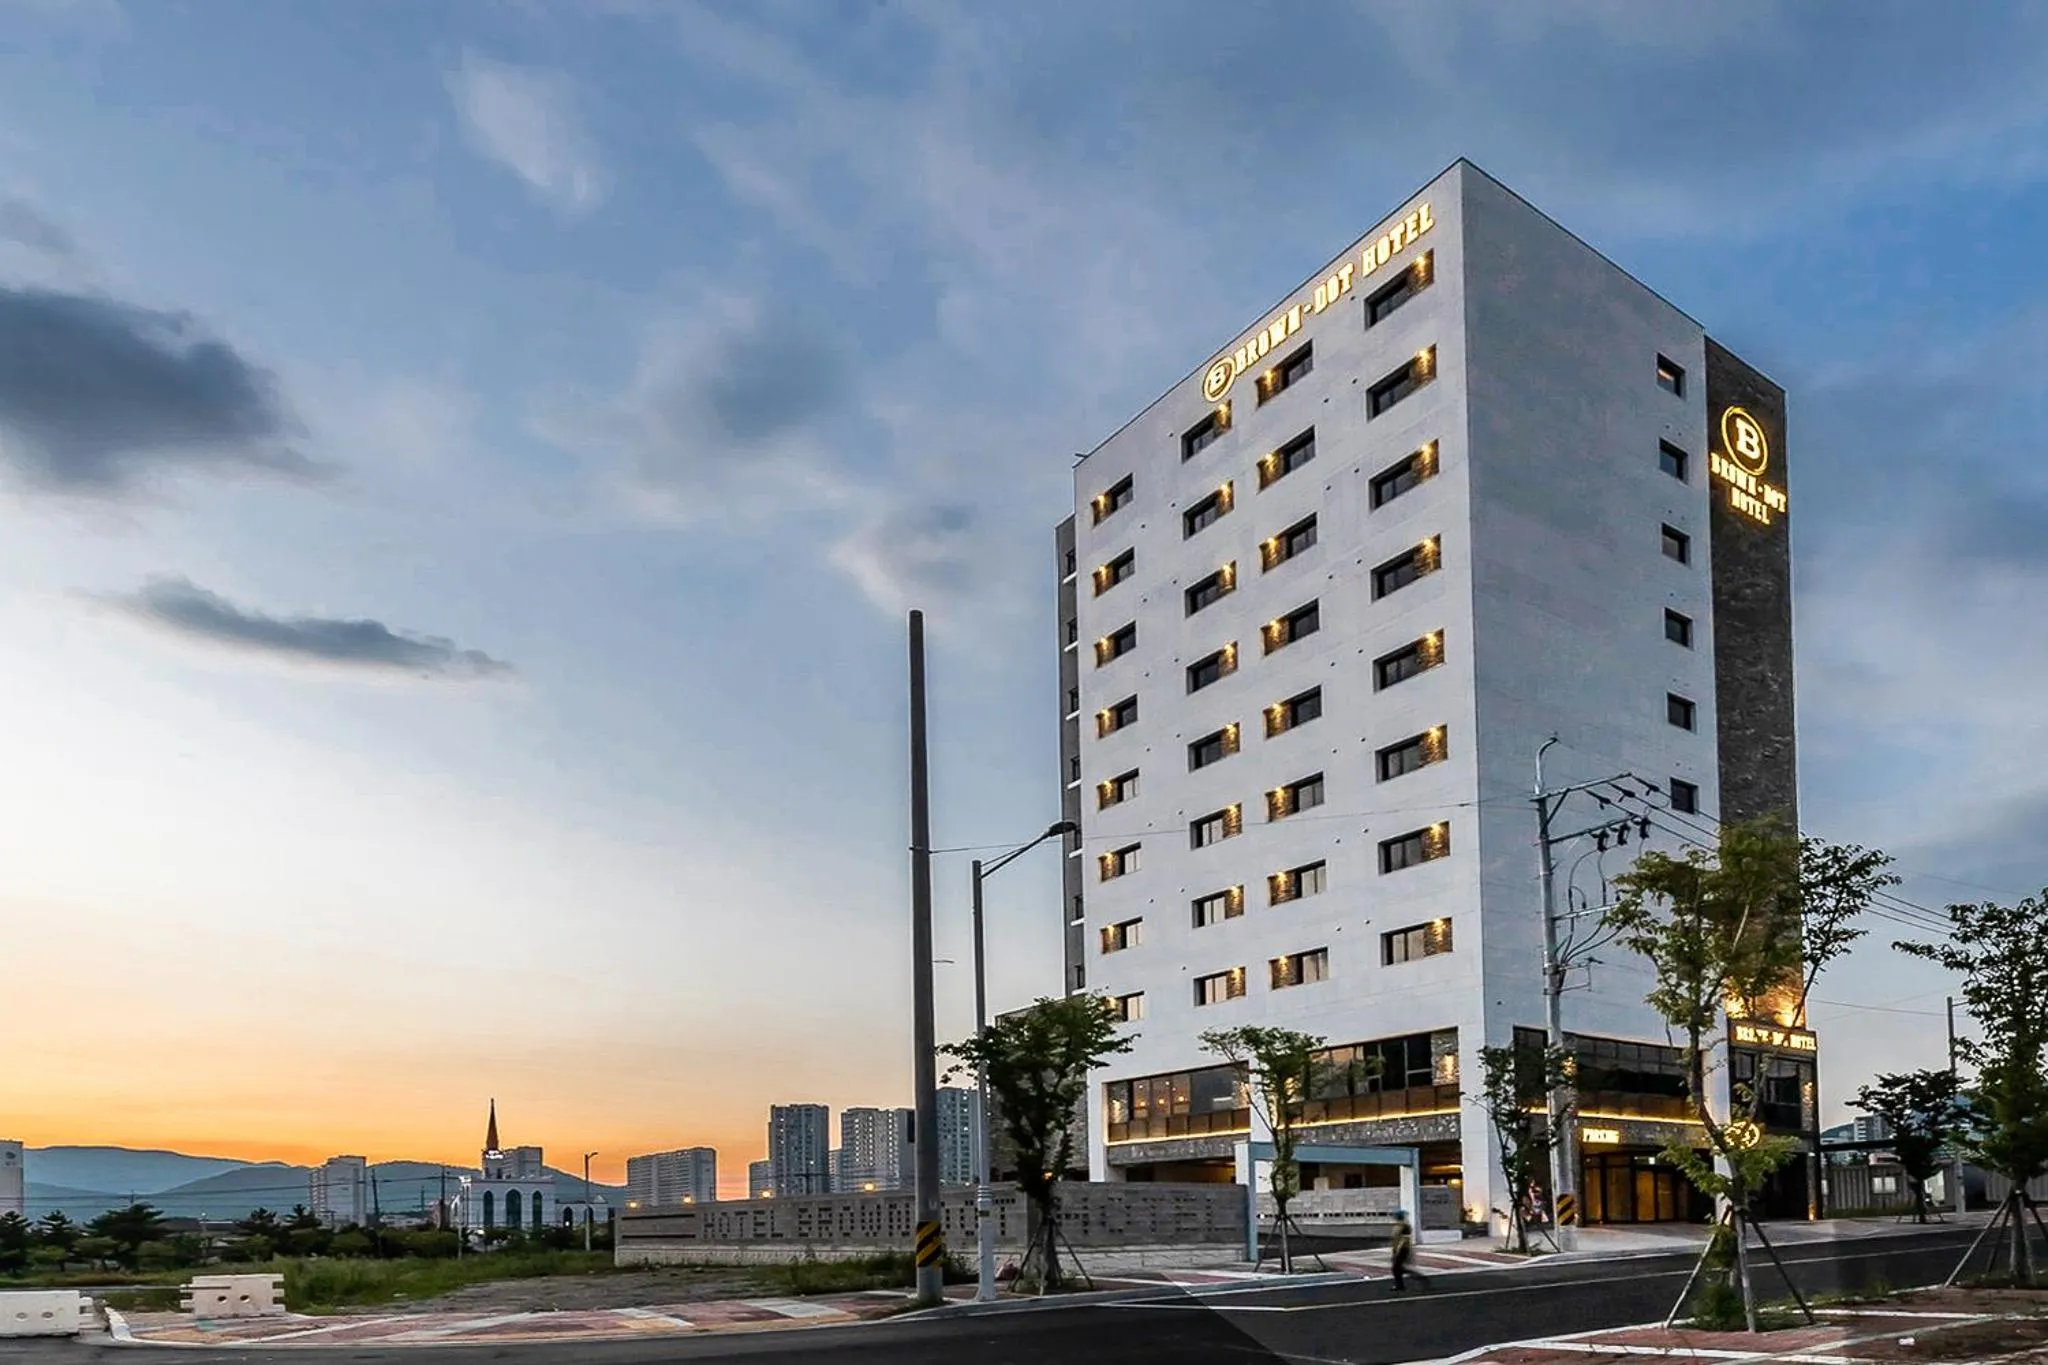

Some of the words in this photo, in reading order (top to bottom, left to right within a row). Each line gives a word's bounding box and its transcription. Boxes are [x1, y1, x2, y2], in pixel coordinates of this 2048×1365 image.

[1361, 203, 1434, 277] HOTEL
[1731, 487, 1770, 525] HOTEL
[704, 1210, 784, 1238] HOTEL
[798, 1203, 911, 1238] BROWN
